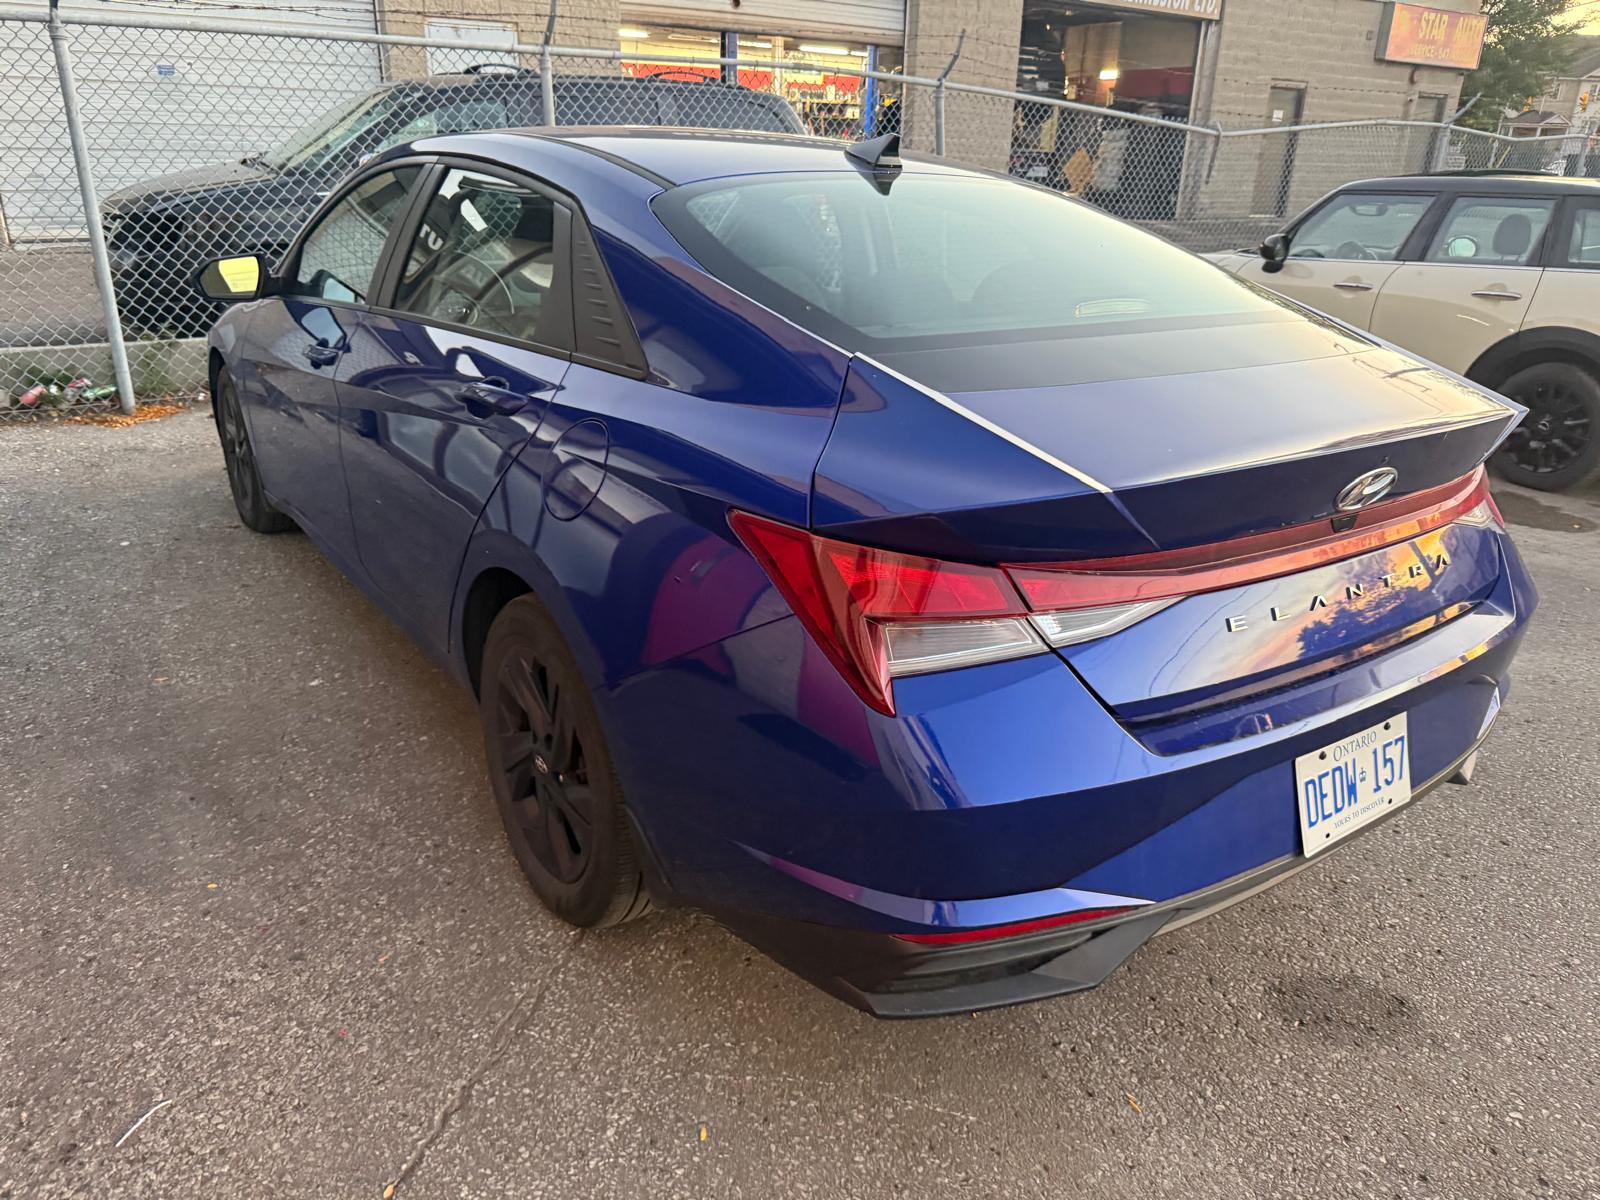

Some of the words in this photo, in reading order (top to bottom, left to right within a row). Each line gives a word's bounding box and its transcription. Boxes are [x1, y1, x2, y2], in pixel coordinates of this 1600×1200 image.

[1419, 11, 1449, 41] STAR
[1225, 554, 1450, 632] ELANTRA
[1304, 758, 1358, 828] DEDW
[1372, 735, 1405, 793] 157
